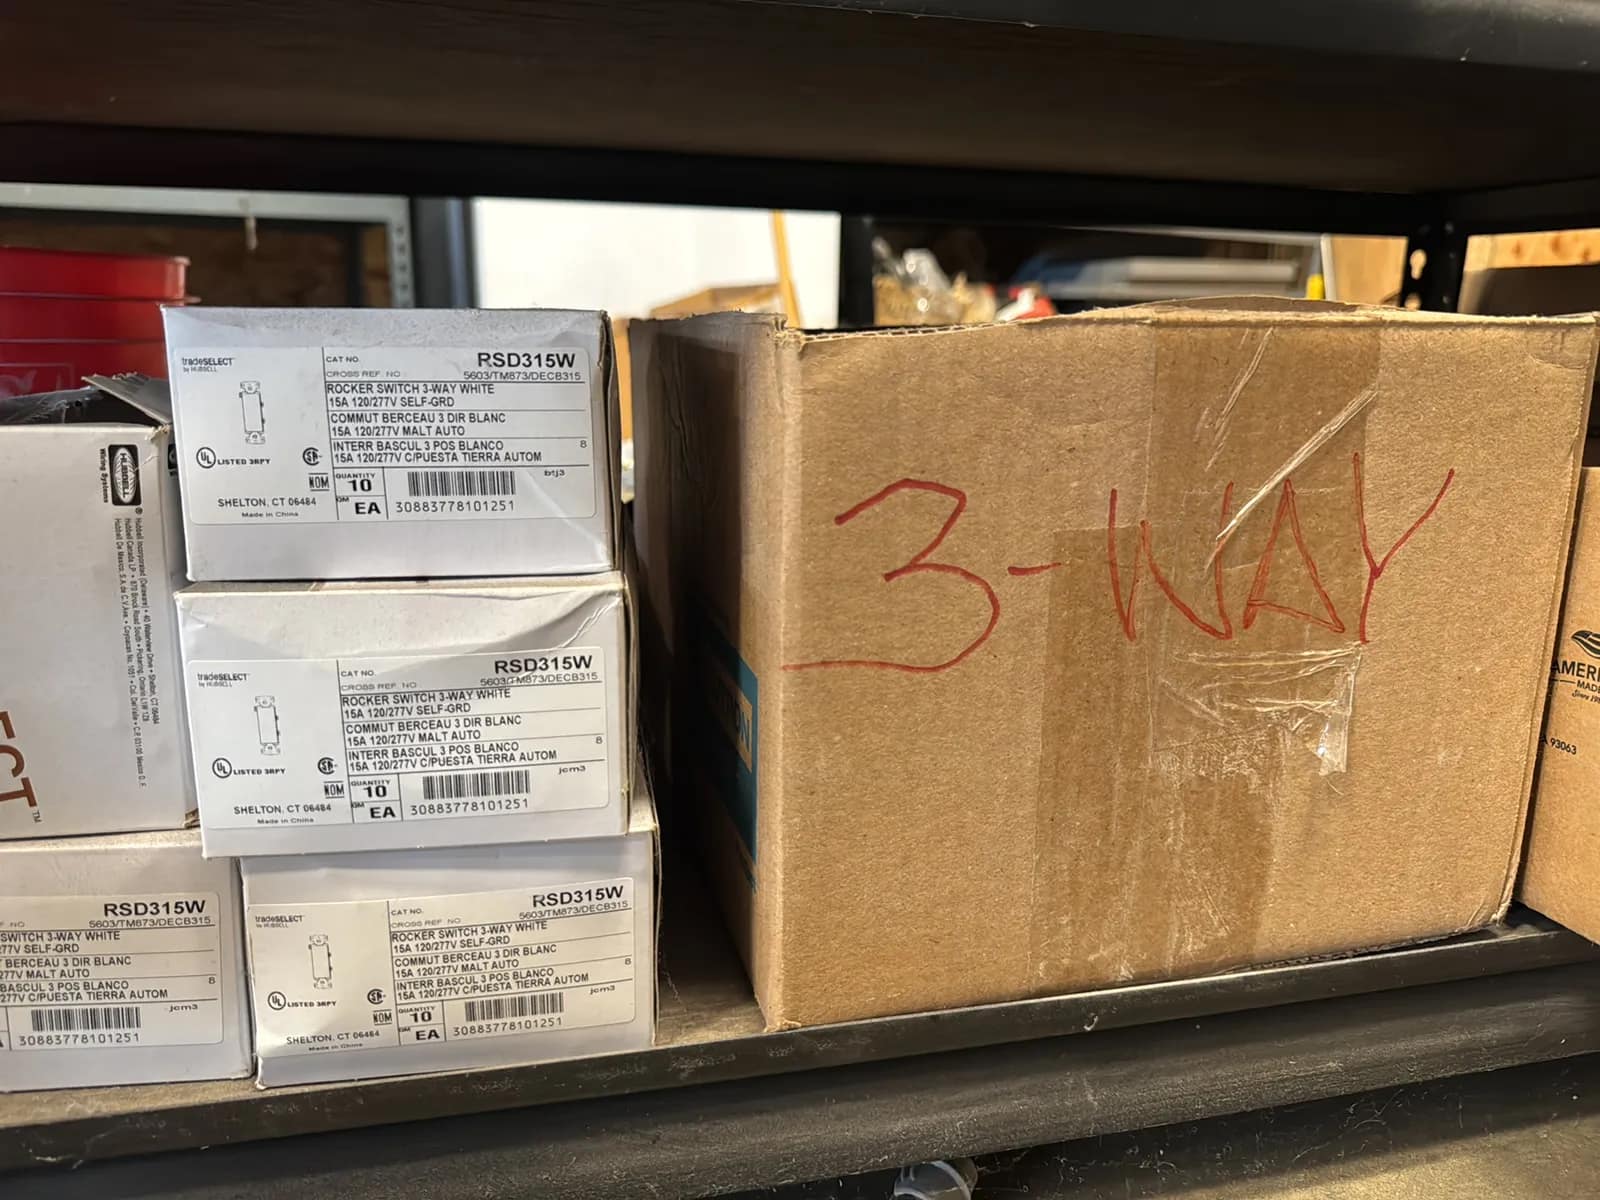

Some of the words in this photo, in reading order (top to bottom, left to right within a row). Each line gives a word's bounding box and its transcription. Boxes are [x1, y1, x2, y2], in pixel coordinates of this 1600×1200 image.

[477, 352, 575, 368] RSD315W
[463, 370, 580, 380] 5603/TM873/DECB315
[326, 382, 373, 394] ROCKER
[376, 383, 419, 394] SWITCH
[422, 383, 456, 393] 3-WAY
[459, 383, 494, 394] WHITE
[329, 396, 348, 407] 15A
[351, 396, 397, 407] 120/277V
[399, 396, 454, 407] SELF-GRD
[330, 412, 379, 423] COMMUT
[381, 412, 435, 423] BERCEAU
[438, 412, 444, 423] 3
[447, 412, 465, 423] DIR
[468, 412, 505, 423] BLANC
[332, 425, 351, 436] 15A
[354, 425, 399, 436] 120/277V
[402, 425, 432, 436] MALT
[435, 425, 465, 436] AUTO
[333, 440, 373, 451] INTERR
[376, 440, 422, 451] BASCUL
[424, 440, 430, 450] 3
[432, 440, 455, 450] POS
[458, 440, 503, 450] BLANCO
[334, 452, 353, 463] 15A
[356, 452, 402, 462] 120/277V
[404, 451, 458, 462] C/PUESTA
[461, 451, 500, 462] TIERRA
[503, 451, 541, 461] AUTOM
[348, 478, 371, 491] 10
[217, 497, 268, 507] SHELTON,
[271, 497, 284, 506] CT
[287, 497, 316, 505] 06484
[354, 501, 380, 514] EA
[395, 499, 513, 512] 30883778101251
[781, 453, 1455, 675] 3-WAY
[494, 654, 592, 673] RSD315W
[341, 694, 389, 706] ROCKER
[392, 692, 435, 704] SWITCH
[439, 689, 473, 701] 3-WAY
[475, 687, 510, 699] WHITE
[344, 708, 364, 719] 15A
[367, 705, 413, 717] 120/277V
[415, 702, 471, 715] SELF-GRD
[345, 721, 394, 734] COMMUT
[397, 719, 451, 731] BERCEAU
[454, 718, 460, 728] 3
[463, 716, 481, 727] DIR
[484, 714, 521, 726] BLANC
[347, 735, 366, 746] 15A
[369, 733, 415, 745] 120/277V
[418, 731, 448, 742] MALT
[451, 729, 480, 740] AUTO
[348, 748, 388, 760] INTERR
[391, 746, 437, 758] BASCUL
[439, 745, 445, 755] 3
[448, 744, 471, 754] POS
[473, 741, 519, 753] BLANCO
[1550, 737, 1577, 755] 93063
[349, 761, 369, 771] 15A
[372, 758, 417, 770] 120/277V
[419, 755, 473, 767] C/PUESTA
[476, 752, 516, 764] TIERRA
[519, 749, 556, 761] AUTOM
[363, 785, 386, 797] 10
[233, 805, 283, 814] SHELTON,
[286, 804, 300, 812] CT
[302, 803, 331, 812] 06484
[369, 806, 395, 818] EA
[410, 798, 527, 815] 30883778101251
[532, 885, 623, 907] RSD315W
[103, 900, 206, 917] RSD315W
[518, 900, 629, 919] 5603/TM873/DECB315
[0, 932, 44, 942] SWITCH
[47, 931, 82, 941] 3-WAY
[85, 931, 120, 941] WHITE
[392, 930, 436, 943] ROCKER
[438, 927, 478, 938] SWITCH
[481, 924, 514, 936] 3-WAY
[516, 921, 547, 932] WHITE
[0, 944, 20, 954] 77V
[24, 943, 80, 954] SELF-GRD
[393, 943, 412, 953] 15A
[414, 940, 457, 952] 120/277V
[459, 935, 510, 948] SELF-GRD
[5, 958, 60, 968] BERCEAU
[63, 958, 69, 967] 3
[72, 957, 91, 967] DIR
[94, 956, 131, 966] BLANC
[394, 954, 440, 967] COMMUT
[442, 950, 491, 963] BERCEAU
[494, 949, 500, 958] 3
[502, 947, 520, 958] DIR
[522, 943, 556, 956] BLANC
[26, 969, 56, 979] MALT
[59, 969, 90, 978] AUTO
[396, 968, 414, 978] 15A
[416, 964, 458, 976] 120/277V
[460, 961, 489, 972] MALT
[490, 958, 519, 969] AUTO
[396, 978, 434, 991] INTERR
[436, 975, 478, 987] BASCUL
[480, 974, 486, 983] 3
[488, 972, 510, 981] POS
[512, 967, 553, 980] BLANCO
[397, 990, 415, 1000] 15A
[418, 986, 460, 998] 120/277V
[462, 980, 512, 994] C/PUESTA
[513, 975, 551, 989] TIERRA
[553, 972, 588, 985] AUTOM
[0, 983, 46, 993] BASCUL
[48, 982, 54, 992] 3
[57, 982, 80, 991] POS
[83, 981, 129, 990] BLANCO
[29, 992, 82, 1001] C/PUESTA
[85, 991, 126, 1000] TIERRA
[130, 989, 168, 999] AUTOM
[409, 1010, 431, 1022] 10
[453, 1017, 561, 1036] 30883778101251
[19, 1033, 140, 1047] 30883778101251
[286, 1034, 334, 1045] SHELTON,
[336, 1032, 349, 1040] CT
[352, 1029, 379, 1039] 06484
[415, 1029, 439, 1040] EA
